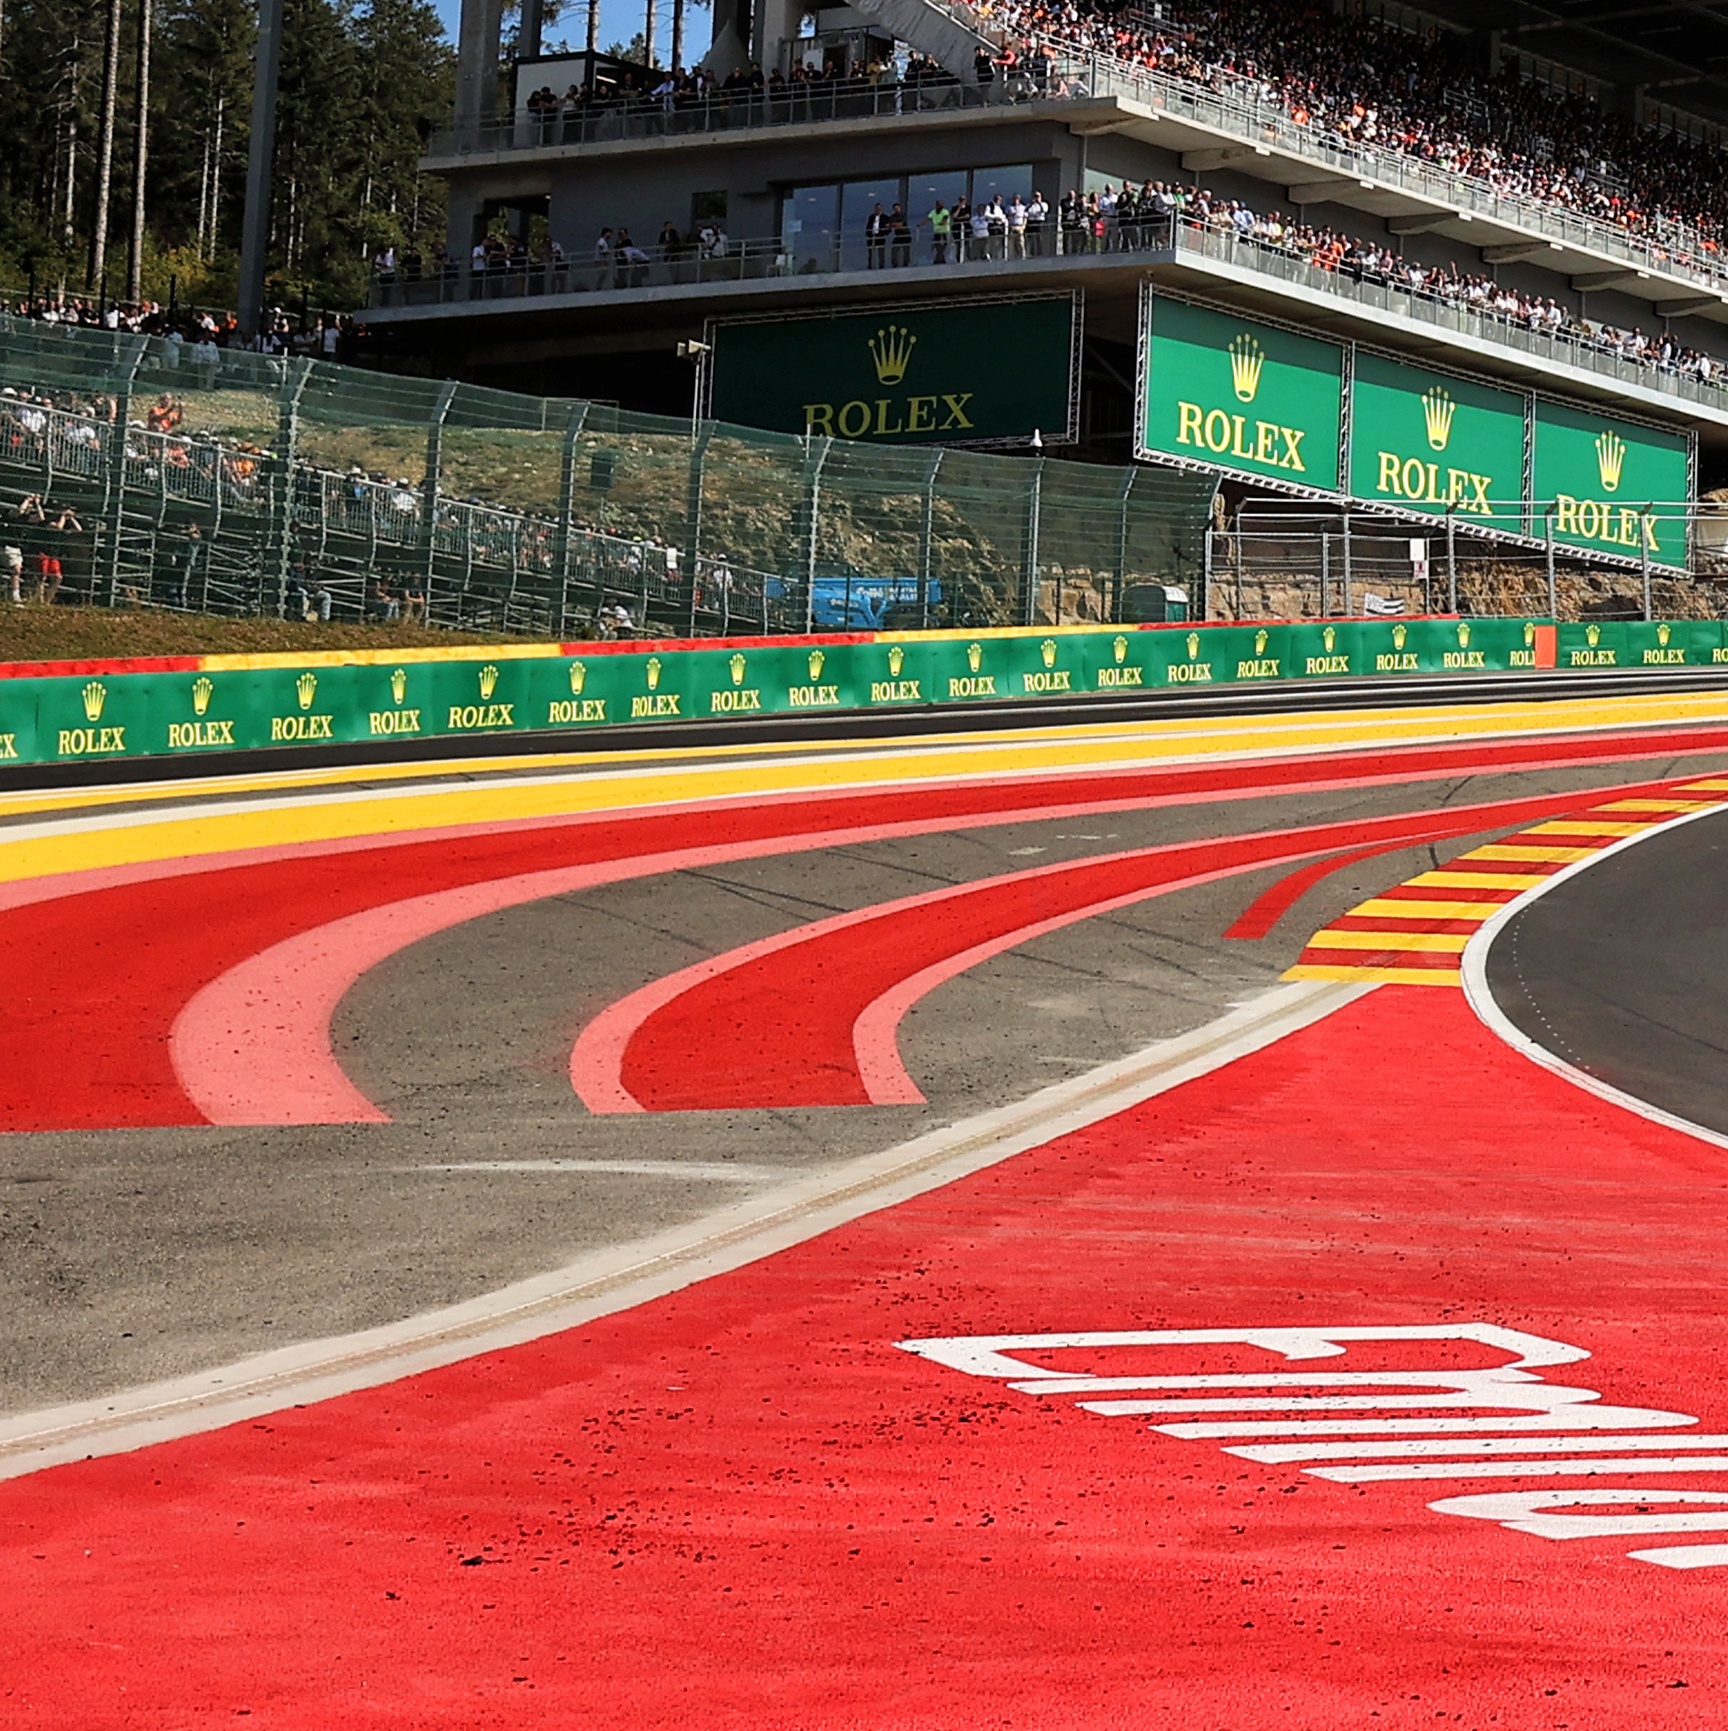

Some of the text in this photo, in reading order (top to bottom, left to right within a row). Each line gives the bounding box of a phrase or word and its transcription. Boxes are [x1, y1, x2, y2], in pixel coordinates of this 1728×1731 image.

[803, 392, 974, 437] ROLEX
[1176, 401, 1306, 472] ROLEX
[1376, 452, 1493, 515] ROLEX
[1556, 494, 1660, 552] ROLEX
[1306, 656, 1349, 674] ROLEX
[1376, 653, 1419, 670] ROLEX
[1443, 651, 1485, 668] ROLEX
[1510, 650, 1535, 666] ROL
[1571, 650, 1616, 666] ROLEX
[1643, 649, 1685, 664] ROLEX
[1098, 667, 1142, 687] ROLEX
[1167, 663, 1212, 683] ROLEX
[1237, 660, 1280, 678] ROLEX
[871, 680, 921, 702] ROLEX
[949, 676, 996, 697] ROLEX
[1023, 671, 1070, 692] ROLEX
[631, 695, 680, 718] ROLEX
[711, 690, 760, 712] ROLEX
[789, 685, 839, 707] ROLEX
[370, 710, 420, 734] ROLEX
[448, 704, 514, 728] ROLEX
[549, 700, 605, 723] ROLEX
[168, 721, 234, 747] ROLEX
[271, 715, 333, 740] ROLEX
[58, 727, 125, 754] ROLEX
